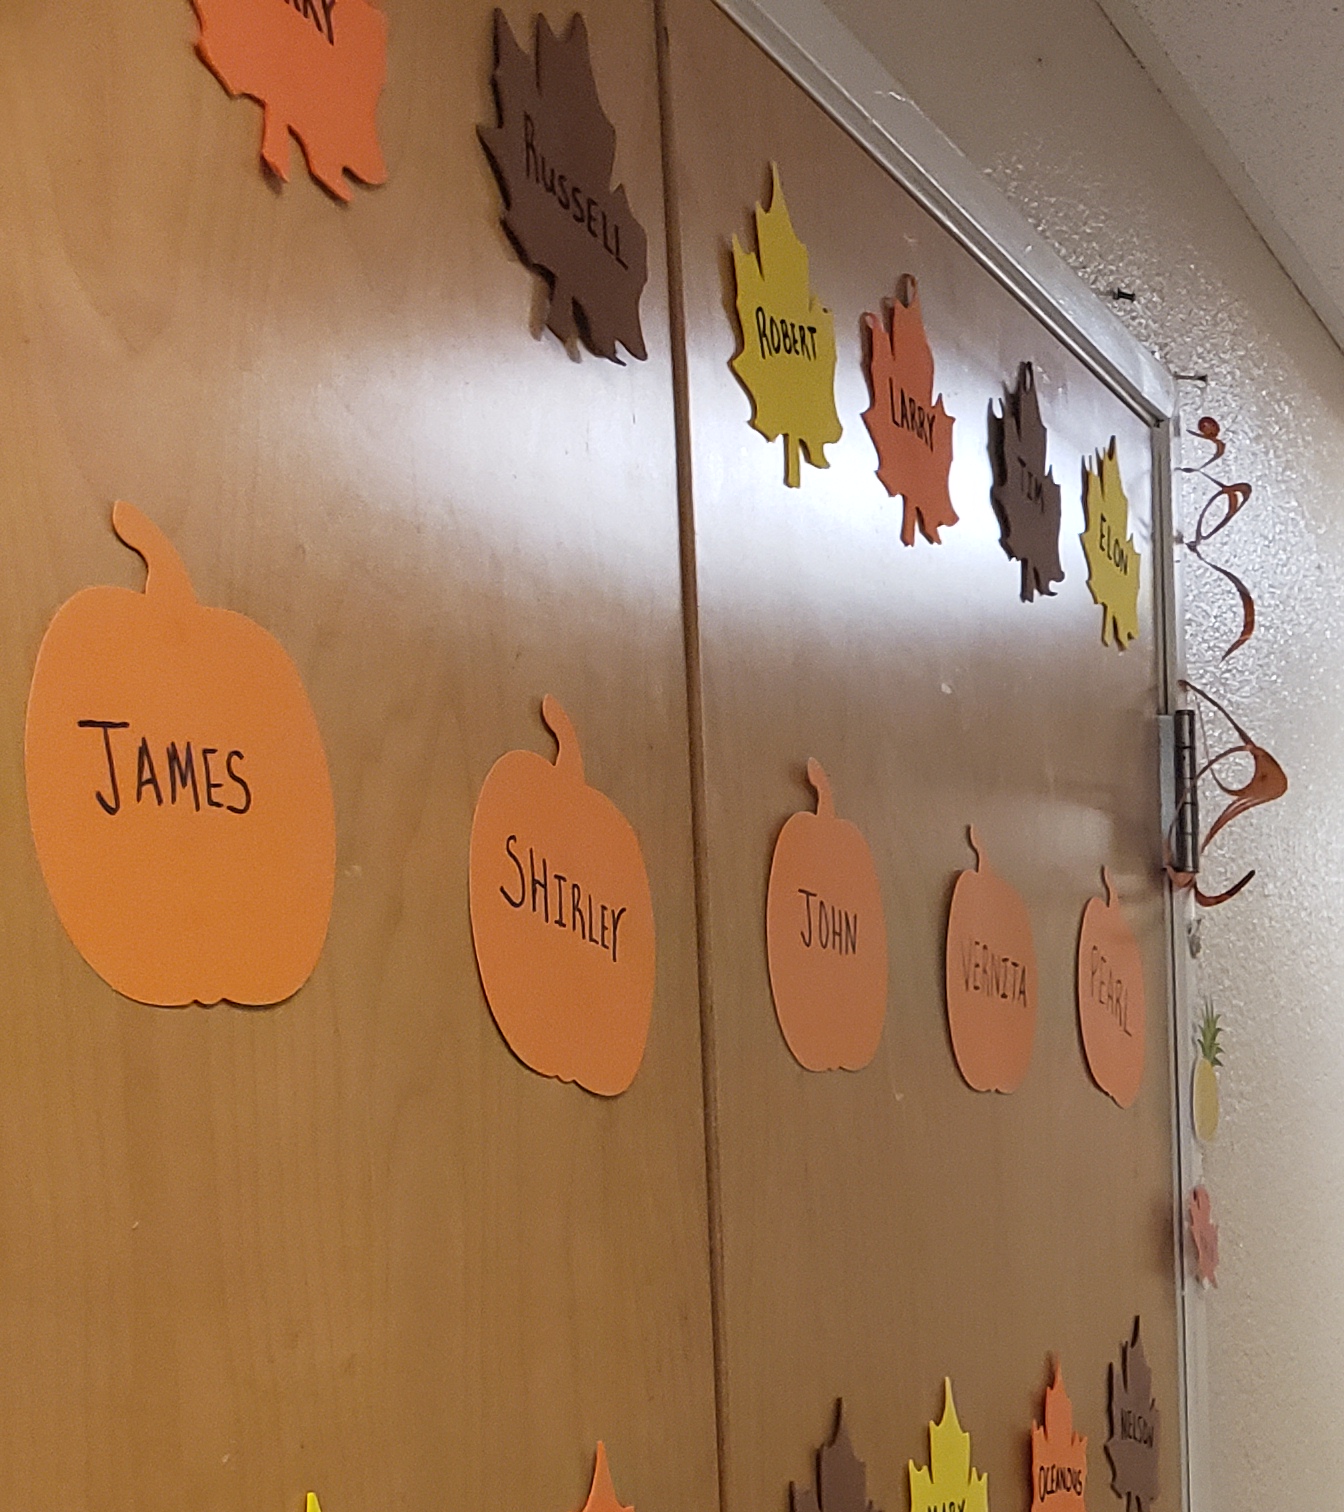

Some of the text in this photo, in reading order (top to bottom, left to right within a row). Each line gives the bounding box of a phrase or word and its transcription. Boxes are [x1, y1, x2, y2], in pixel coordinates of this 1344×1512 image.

[755, 306, 817, 362] ROBERT
[888, 377, 935, 452] LARRY
[1100, 513, 1128, 576] ELON
[77, 719, 252, 815] JAMES
[500, 834, 627, 963] SHIRLEY
[798, 888, 857, 956] JOHN
[960, 937, 1027, 1008] VERNITA
[1091, 945, 1132, 1037] PEARL
[1120, 1408, 1154, 1448] NELSON
